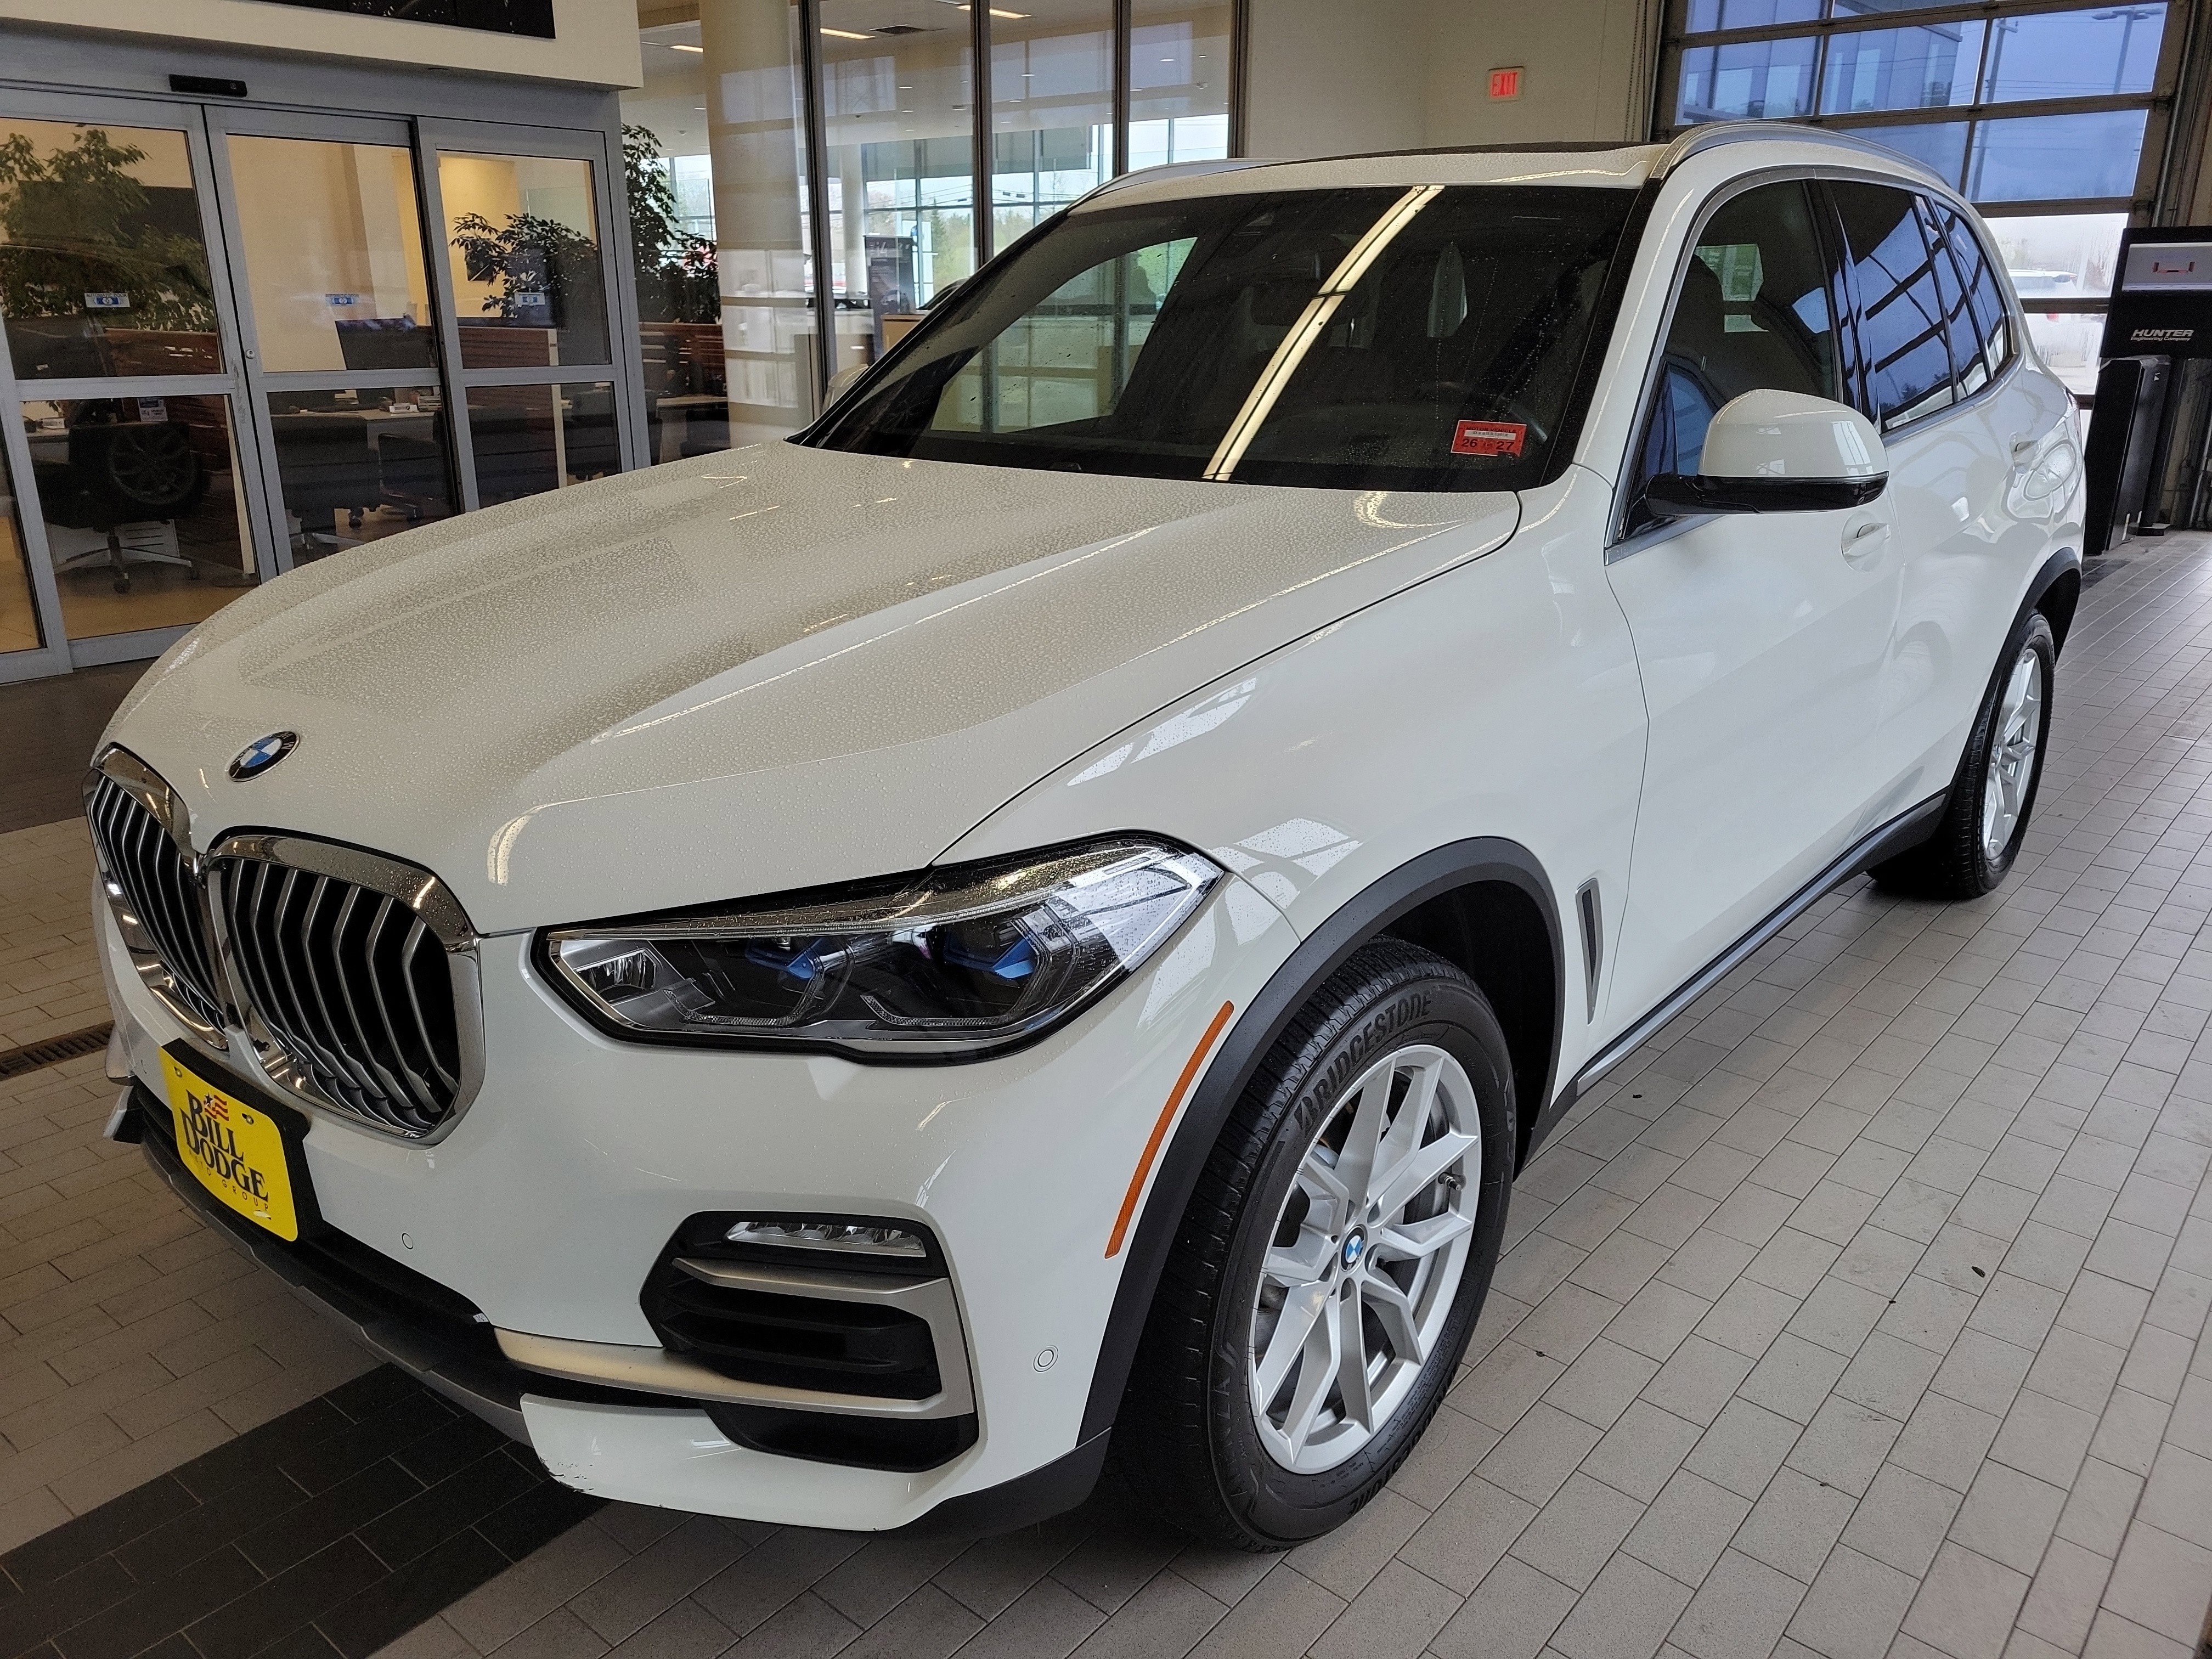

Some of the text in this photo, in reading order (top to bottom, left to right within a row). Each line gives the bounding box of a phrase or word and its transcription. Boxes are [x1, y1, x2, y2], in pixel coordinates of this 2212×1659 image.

[1492, 72, 1517, 96] EXIT
[1460, 438, 1478, 448] 26
[1496, 441, 1515, 450] 27
[1294, 990, 1432, 1139] BRIDGESTONE
[186, 1090, 245, 1162] BILL
[179, 1107, 269, 1203] DODGE
[221, 1178, 269, 1212] GROUP
